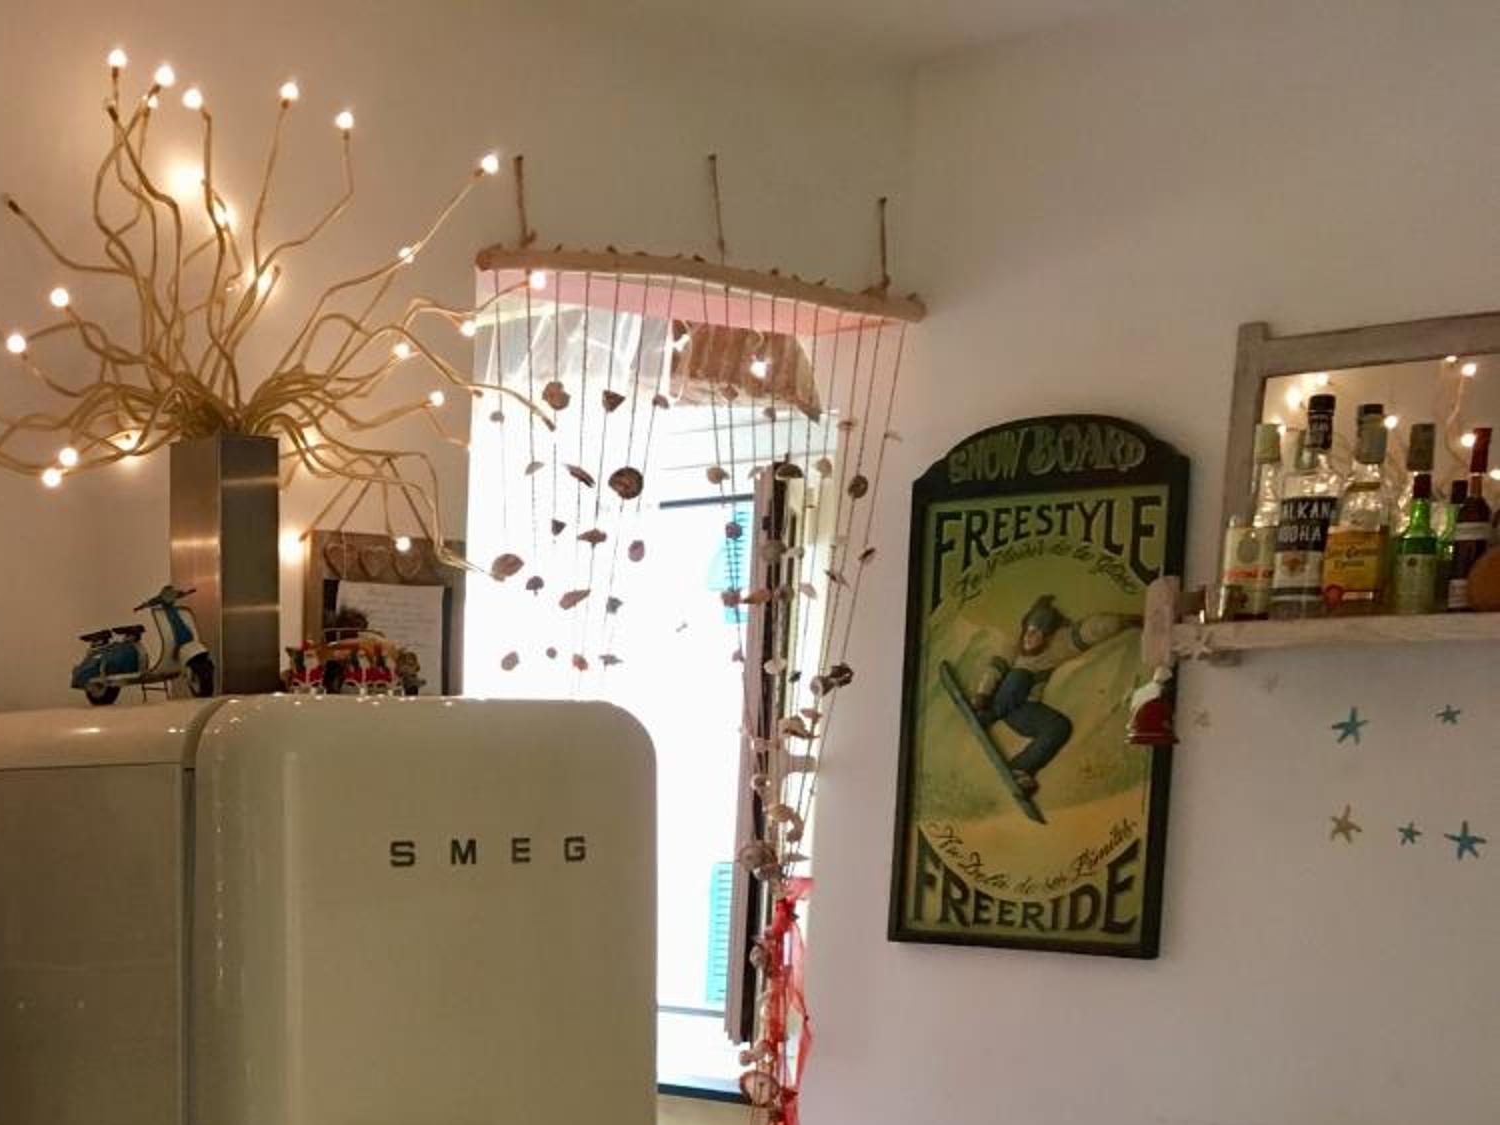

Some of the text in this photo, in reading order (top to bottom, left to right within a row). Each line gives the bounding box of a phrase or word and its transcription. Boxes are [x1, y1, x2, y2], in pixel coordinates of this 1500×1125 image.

[950, 422, 1147, 484] SNOW BOARD
[931, 495, 1162, 616] FREESTYLE
[389, 836, 587, 868] SMEG
[913, 826, 1141, 935] FREERIDE
